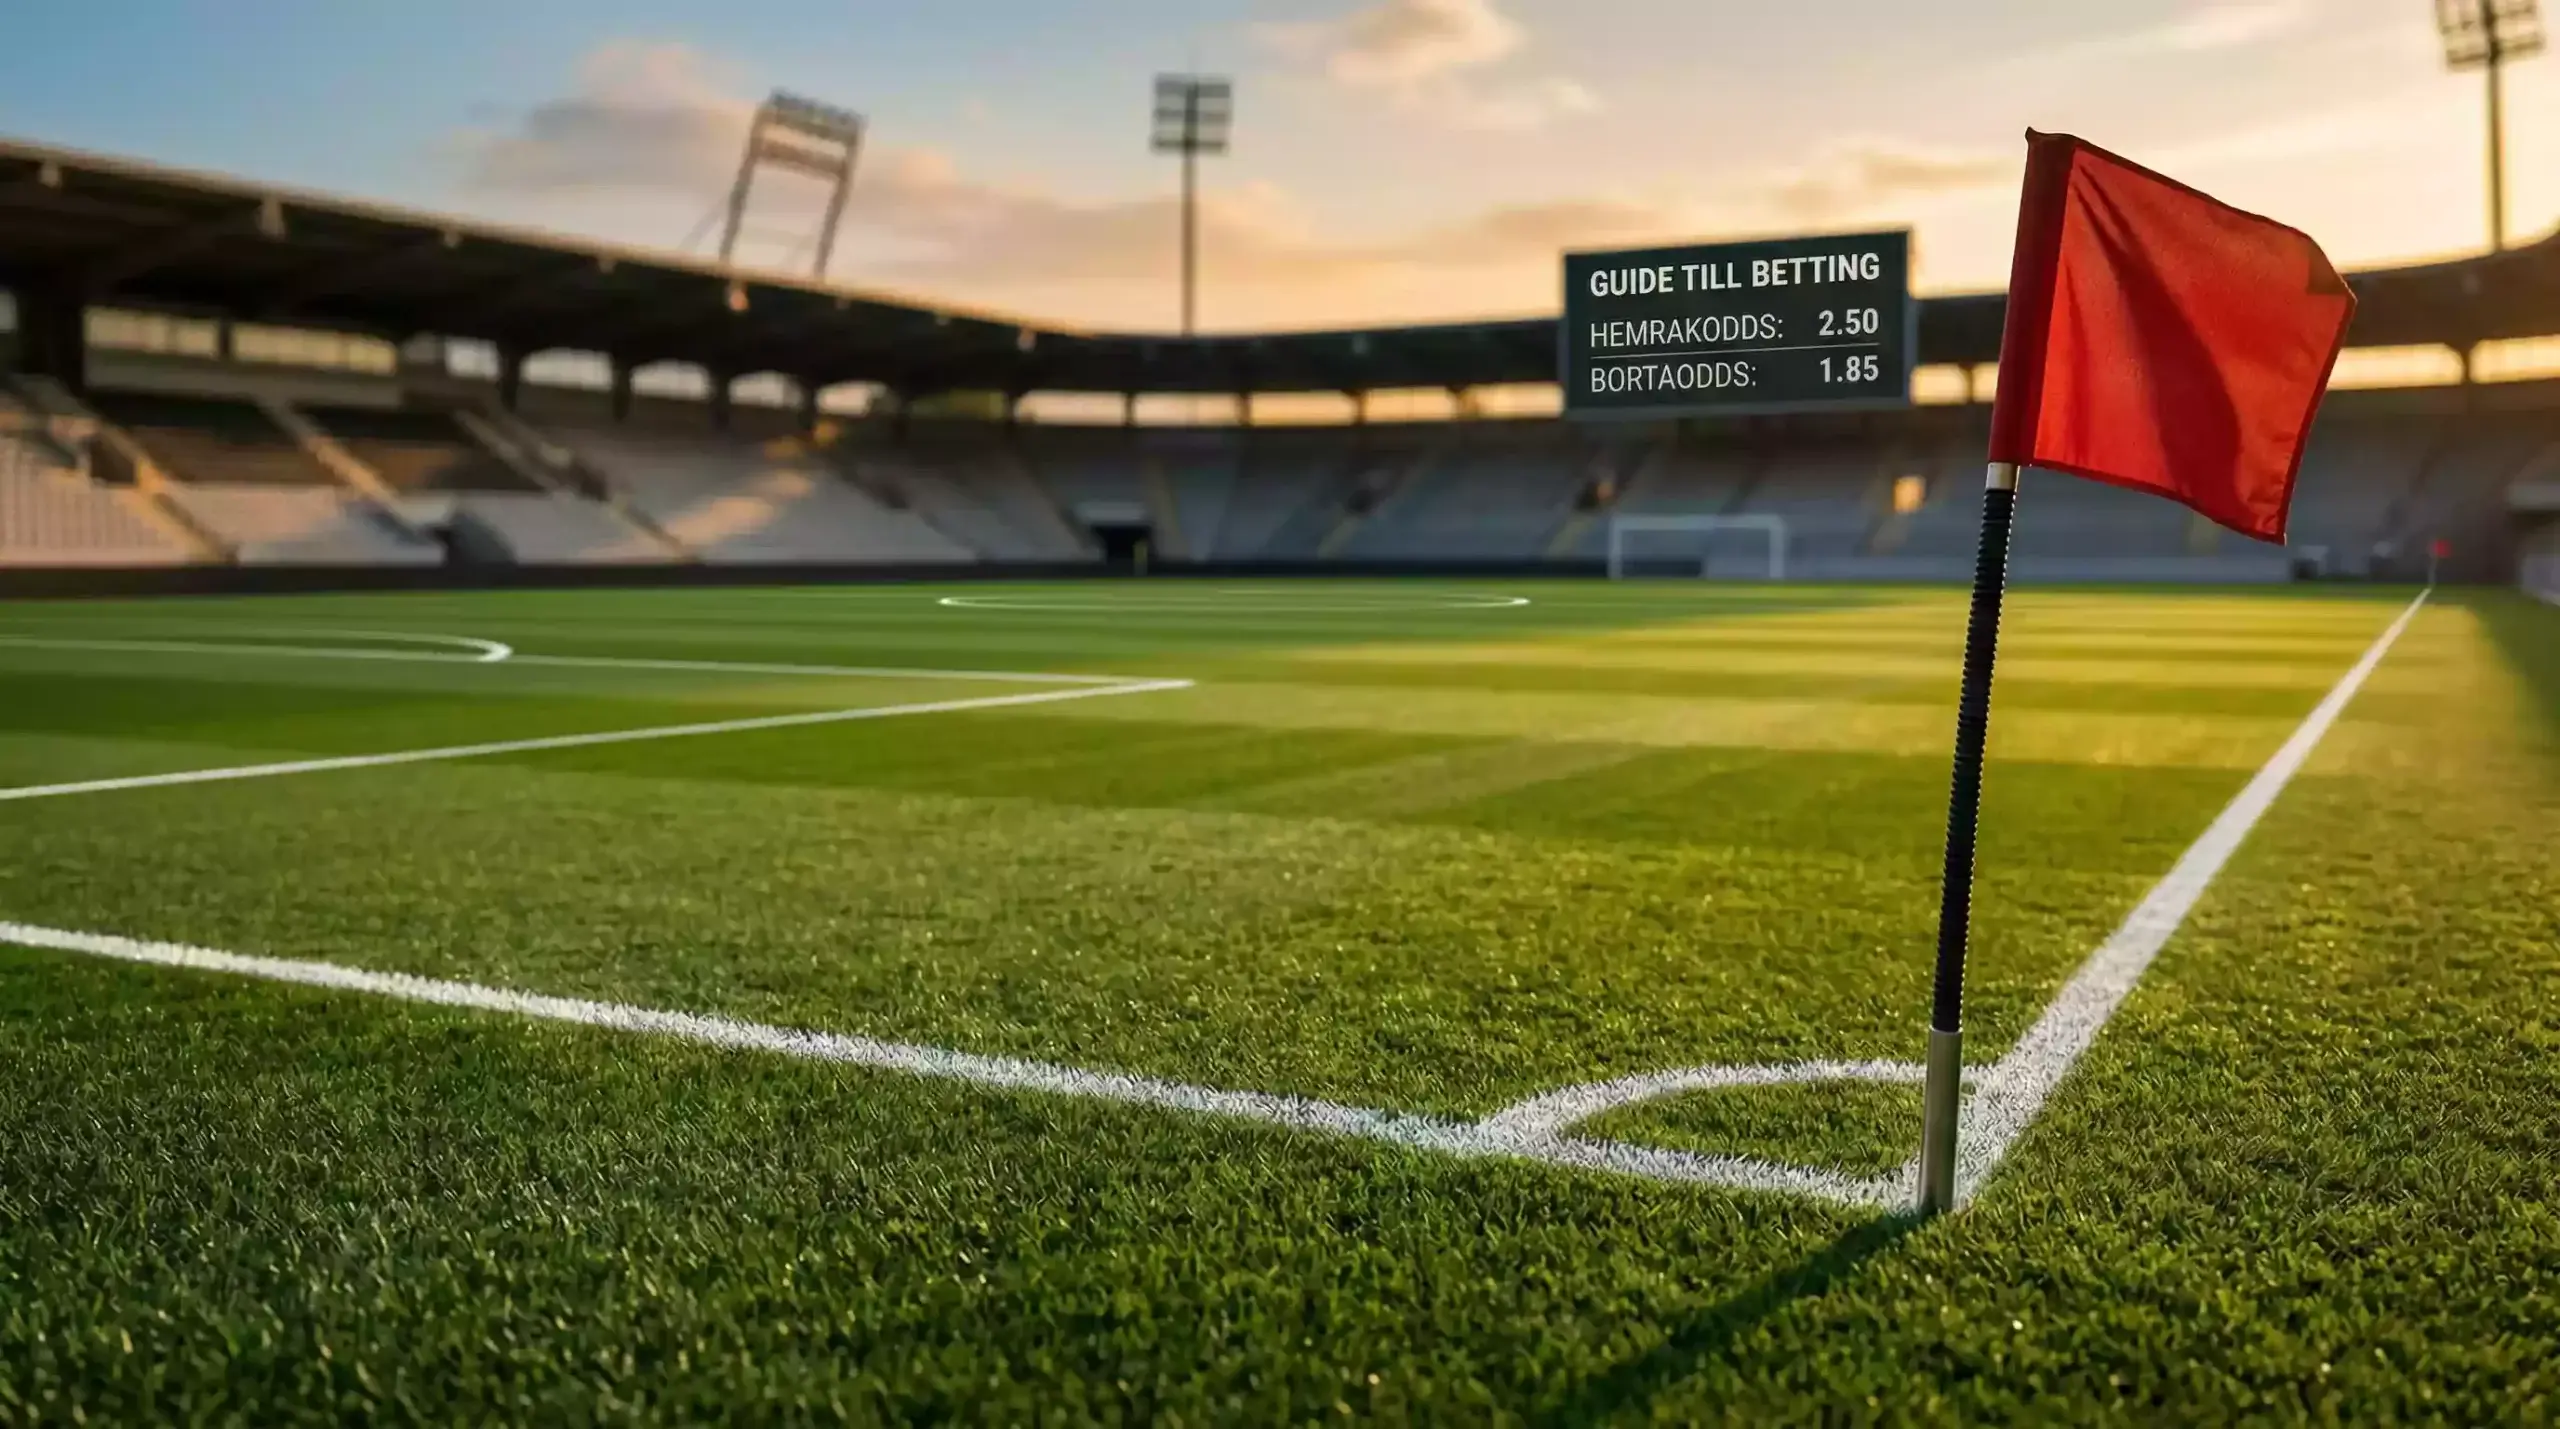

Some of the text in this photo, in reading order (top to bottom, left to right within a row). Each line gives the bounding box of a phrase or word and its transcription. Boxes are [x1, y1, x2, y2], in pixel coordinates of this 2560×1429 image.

[1590, 253, 1880, 297] GUIDE TILL BETTING
[1590, 308, 1879, 348] HEMRAKODDS: 2.50
[1591, 355, 1879, 393] BORTAODDS: 1.85
